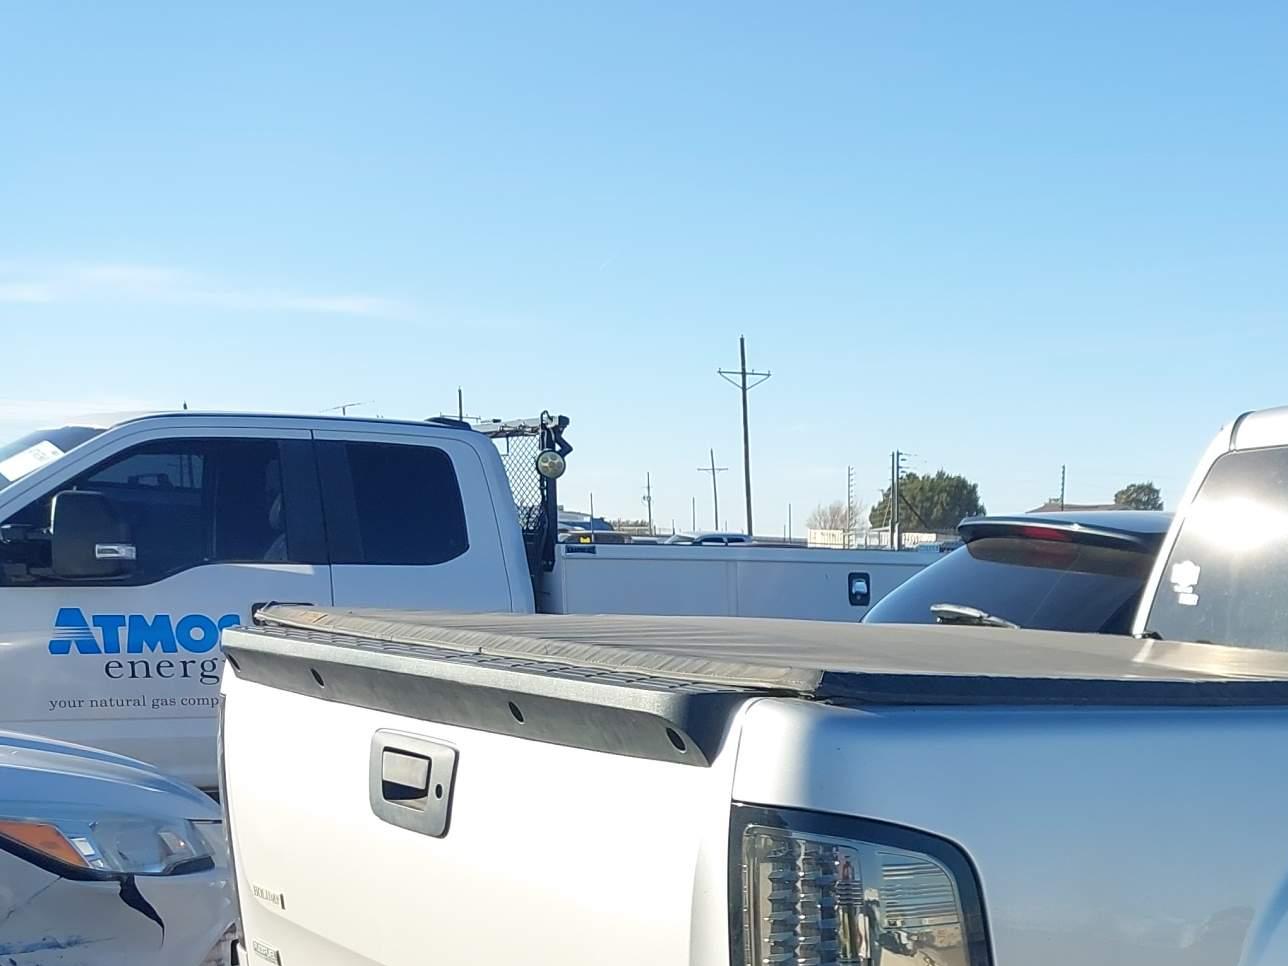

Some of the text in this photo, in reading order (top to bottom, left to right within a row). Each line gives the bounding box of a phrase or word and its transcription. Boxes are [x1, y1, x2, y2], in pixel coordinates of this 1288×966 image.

[104, 658, 222, 685] energ
[49, 698, 84, 711] your
[89, 695, 147, 708] natural
[151, 697, 176, 709] gas
